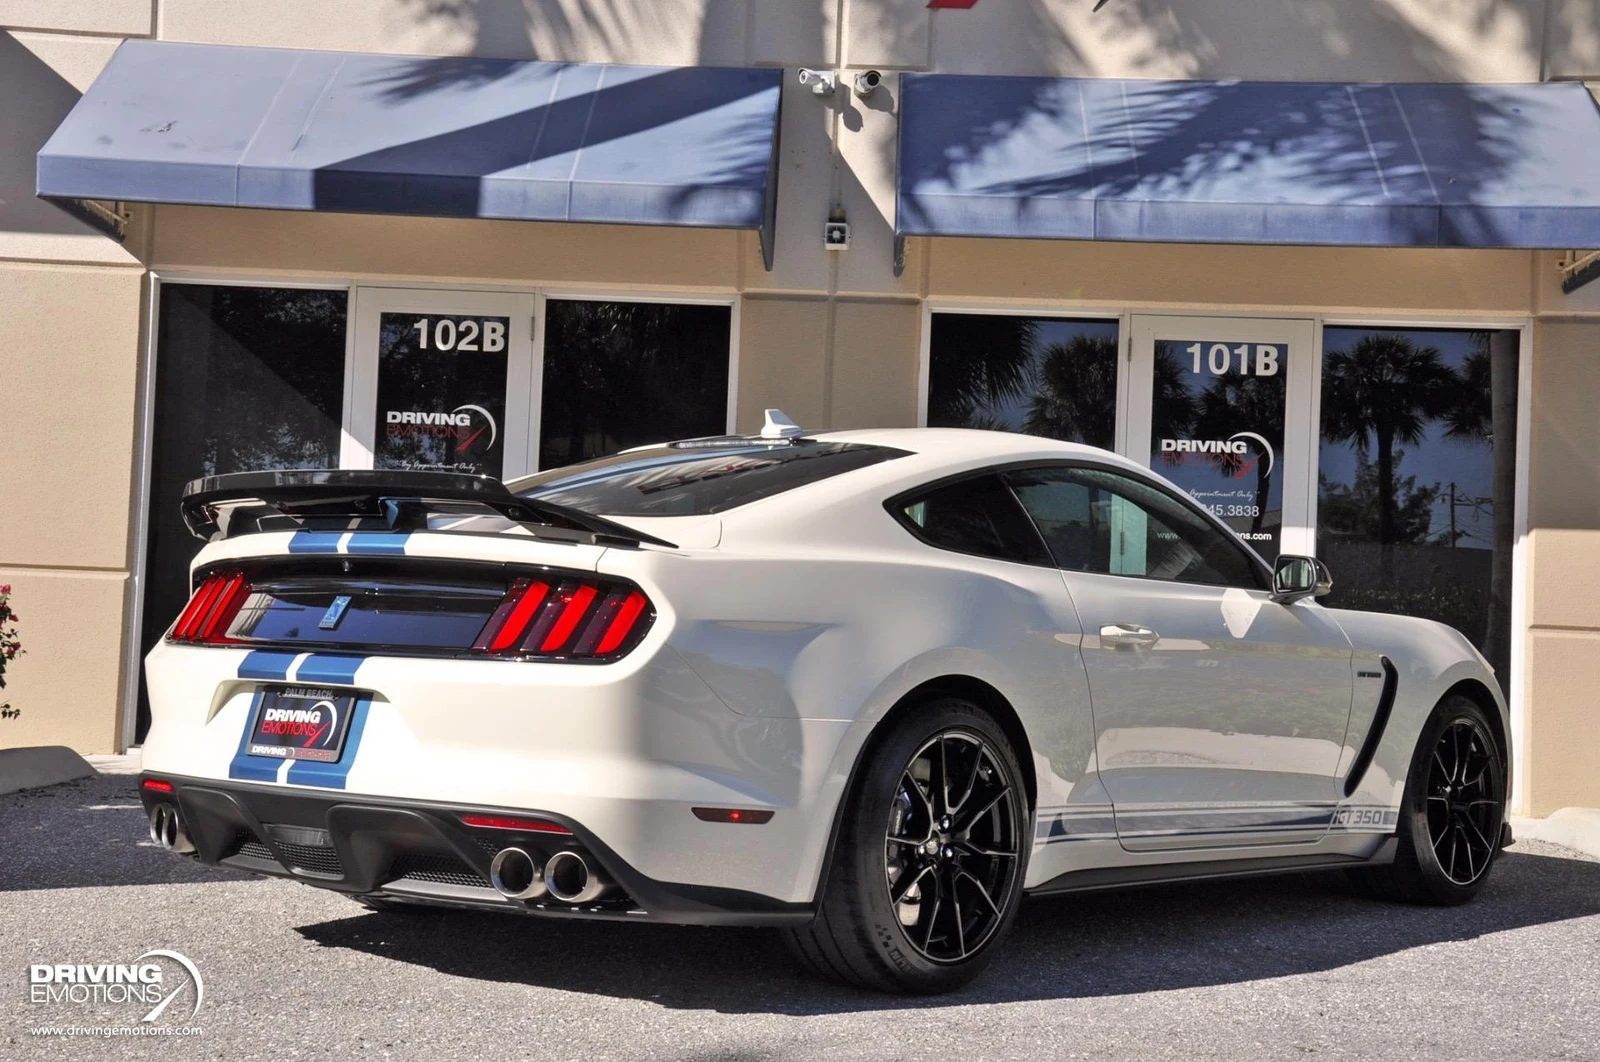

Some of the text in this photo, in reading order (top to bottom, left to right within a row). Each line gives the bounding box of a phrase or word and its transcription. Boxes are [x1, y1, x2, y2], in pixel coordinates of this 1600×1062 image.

[413, 318, 506, 353] 102B
[1186, 342, 1279, 377] 101B
[386, 411, 471, 426] DRIVING
[385, 424, 471, 439] EMOTIONS
[1161, 438, 1248, 454] DRIVING
[1160, 451, 1246, 467] EMOTIONS
[265, 708, 322, 723] DRIVING
[261, 721, 318, 736] EMOTIONS
[251, 745, 287, 756] DRIVING
